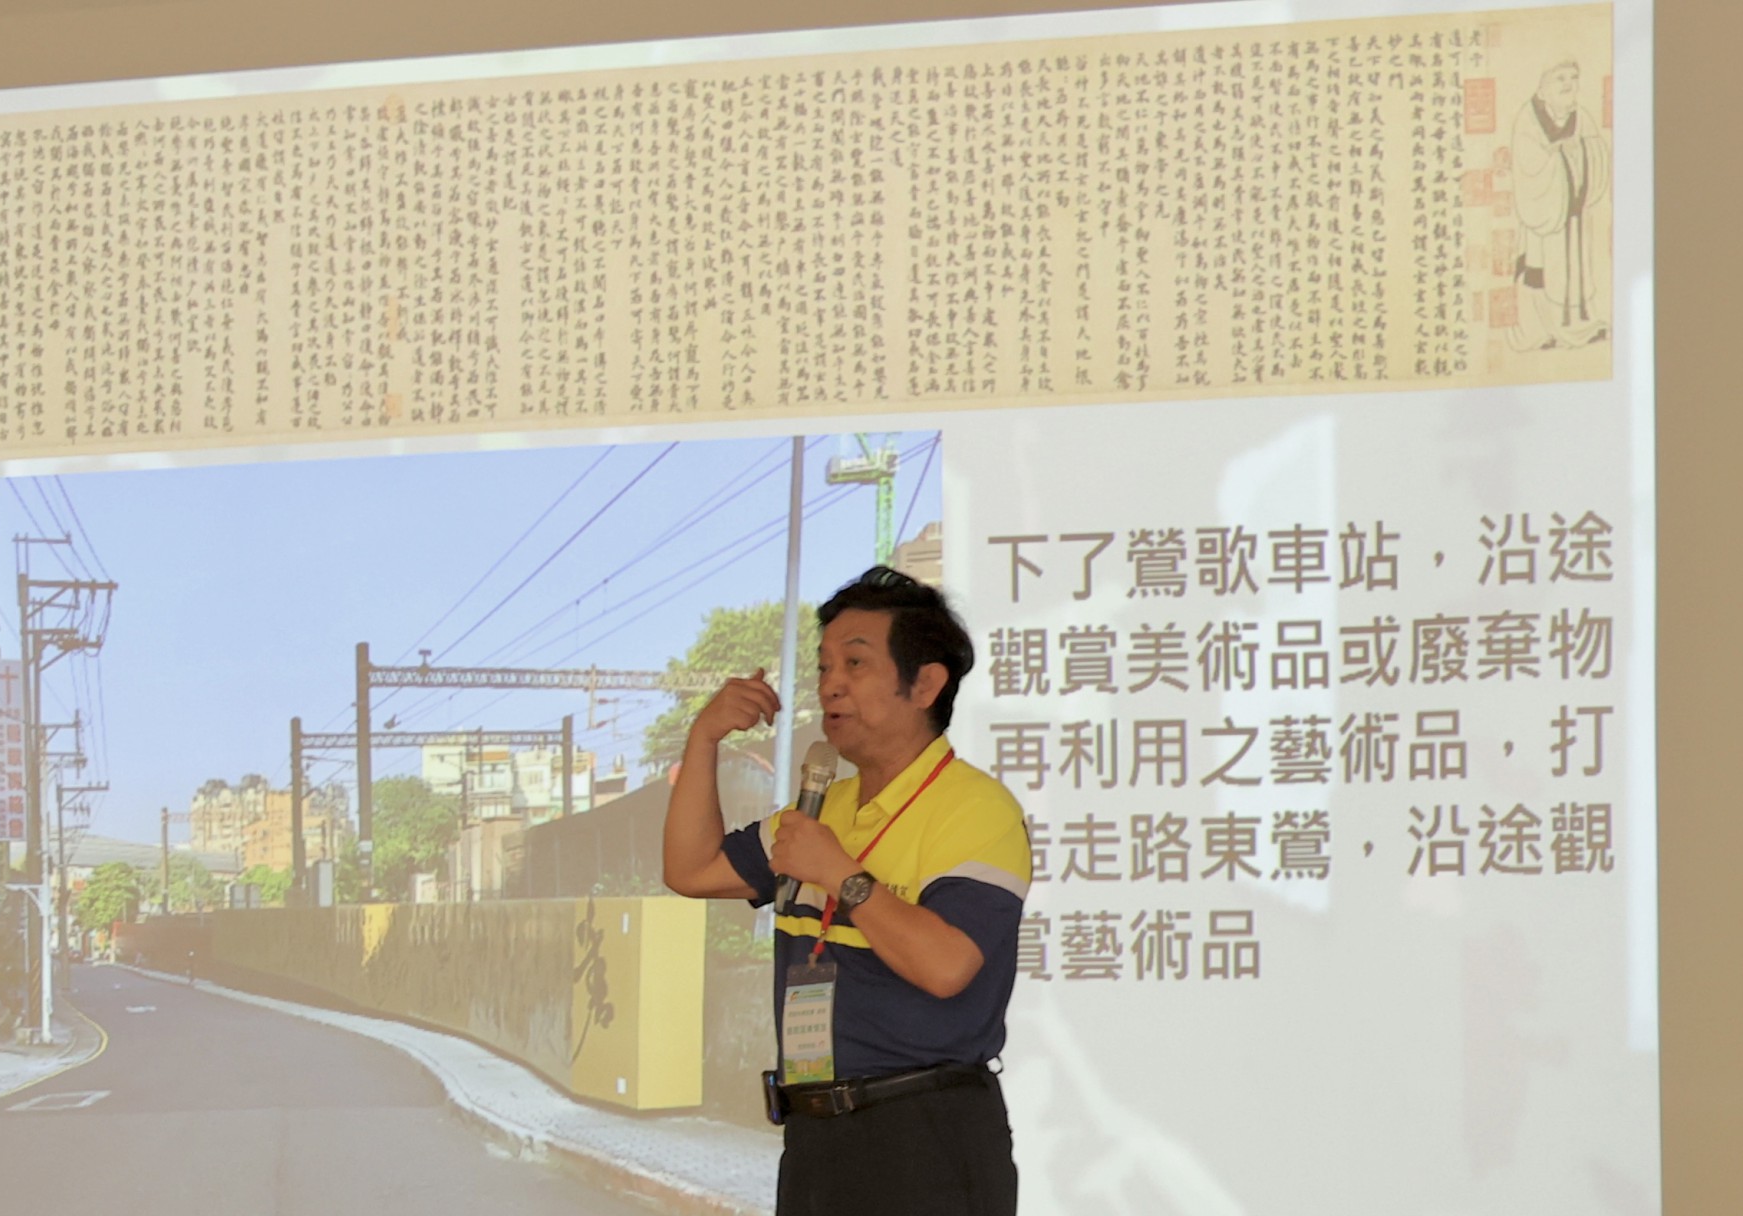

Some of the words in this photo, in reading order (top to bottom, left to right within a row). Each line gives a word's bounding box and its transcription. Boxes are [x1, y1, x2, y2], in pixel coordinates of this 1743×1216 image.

[987, 510, 1614, 603] 下了鶯歌車站，沿途
[988, 607, 1614, 698] 觀賞美術品或廢棄物
